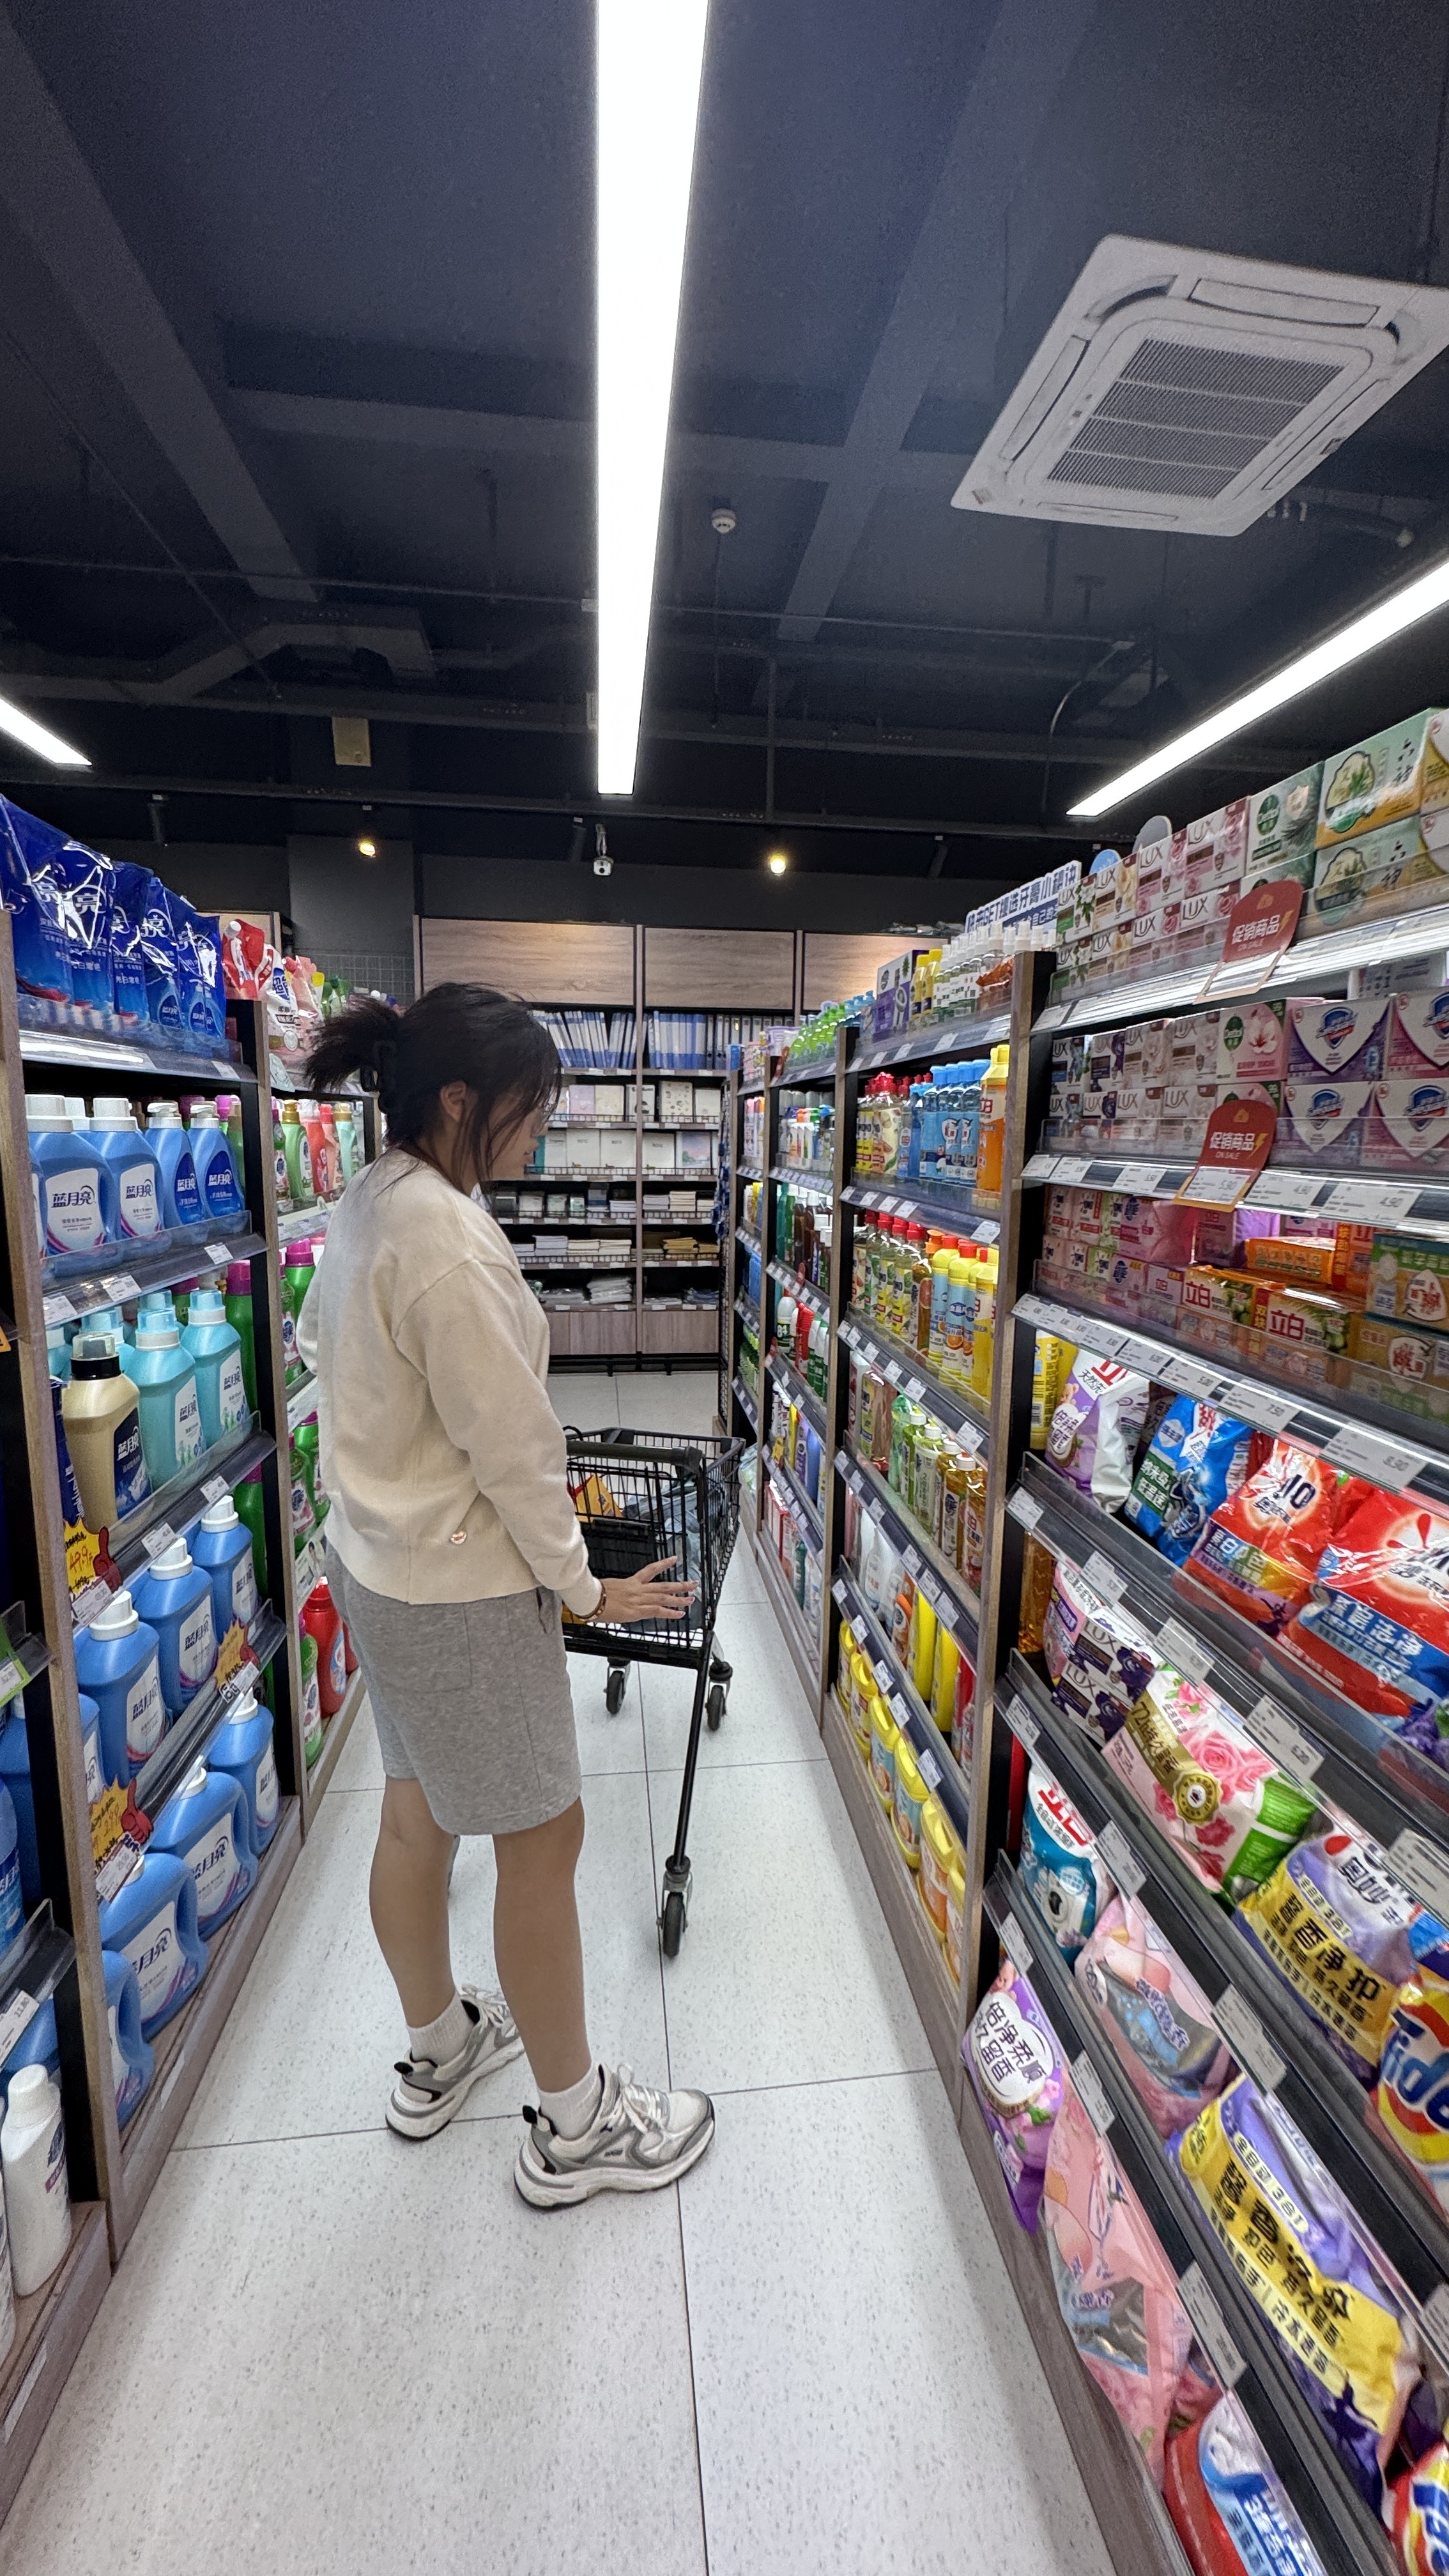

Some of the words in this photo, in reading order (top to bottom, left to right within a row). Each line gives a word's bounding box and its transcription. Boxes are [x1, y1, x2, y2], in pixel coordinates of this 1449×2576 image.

[1188, 818, 1215, 845] LUX
[1140, 846, 1163, 868] LUX
[1096, 868, 1116, 890] LUX
[1183, 896, 1208, 920] LUX
[1135, 916, 1156, 937] LUX
[1231, 914, 1280, 945] 促销商品
[1093, 932, 1111, 953] LUX
[1052, 1041, 1068, 1058] UX
[1049, 1098, 1064, 1113] UX
[1118, 1092, 1139, 1110] LUX
[1165, 1089, 1188, 1109] LUX
[1209, 1131, 1255, 1151] 促销商品
[1225, 1152, 1241, 1160] SALE
[176, 1173, 196, 1192] 蓝月亮
[208, 1169, 232, 1186] 蓝月亮
[51, 1186, 96, 1208] 蓝月亮
[125, 1179, 154, 1200] 蓝月亮
[1185, 1280, 1211, 1309] 立白
[777, 1325, 788, 1338] 84
[1269, 1309, 1305, 1341] 立白
[224, 1367, 241, 1390] 蓝月亮
[116, 1426, 139, 1461] 蓝月亮
[183, 1614, 210, 1652] 蓝月亮
[1085, 1620, 1118, 1655] LUX
[1065, 1662, 1096, 1698] LUX
[132, 1676, 159, 1722] 蓝月亮
[132, 1926, 171, 1974] 月亮
[985, 2001, 1048, 2085] 倍净柔顺
